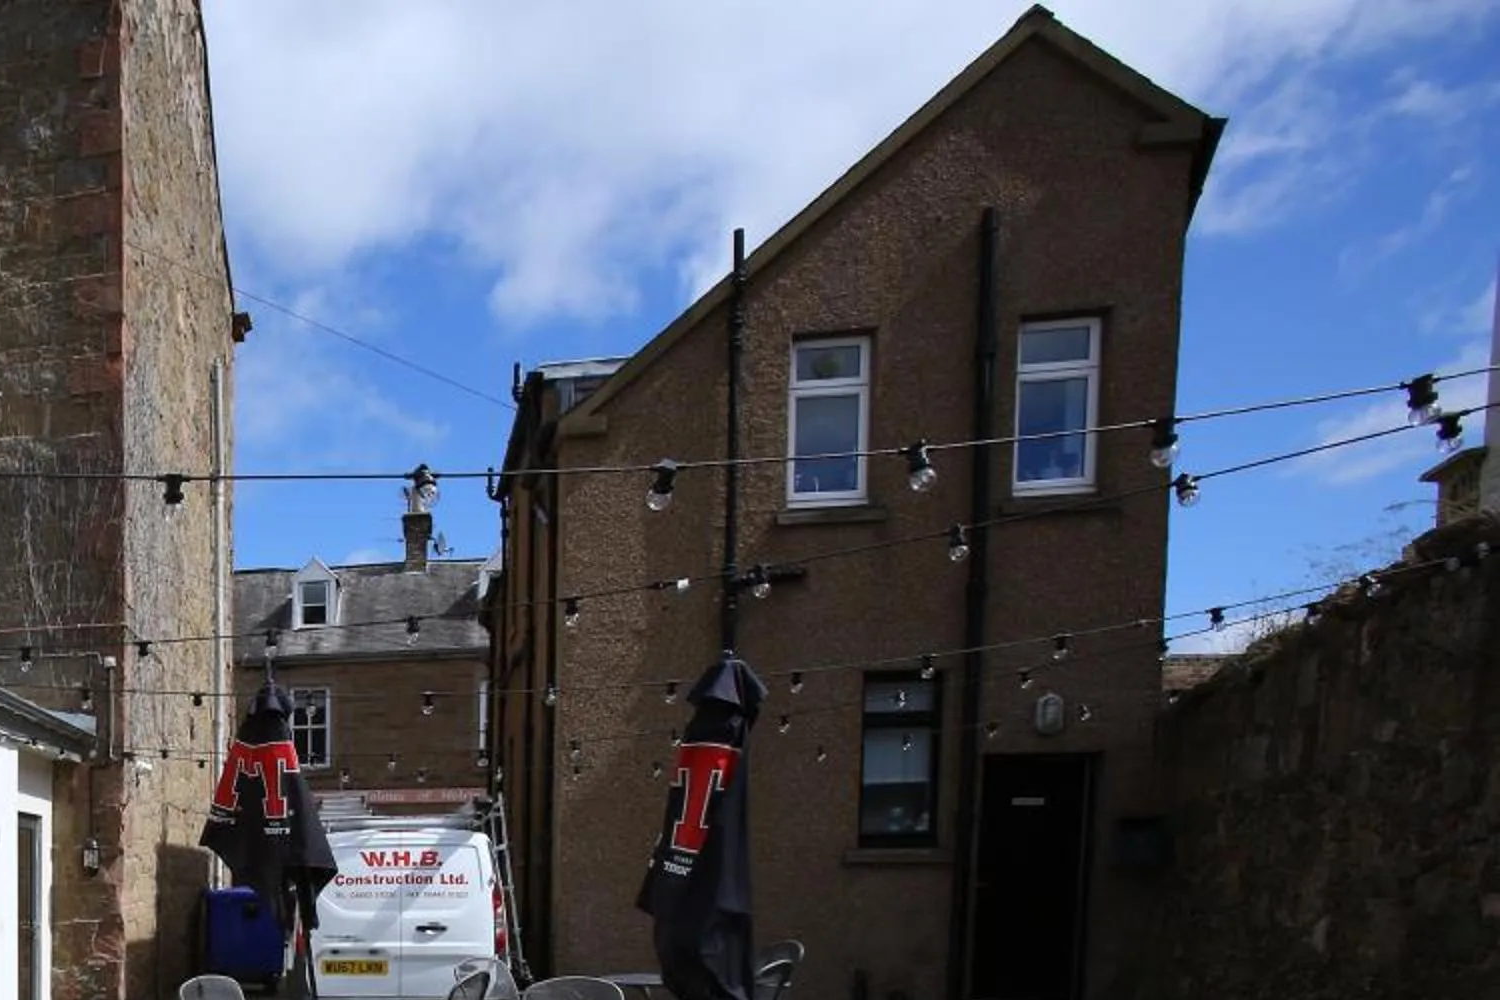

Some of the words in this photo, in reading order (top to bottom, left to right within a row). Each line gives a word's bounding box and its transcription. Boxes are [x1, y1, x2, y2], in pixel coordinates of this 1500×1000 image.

[669, 741, 740, 854] T
[359, 850, 444, 867] W.H.B.
[334, 873, 433, 887] Construction
[440, 873, 469, 886] Ltd.
